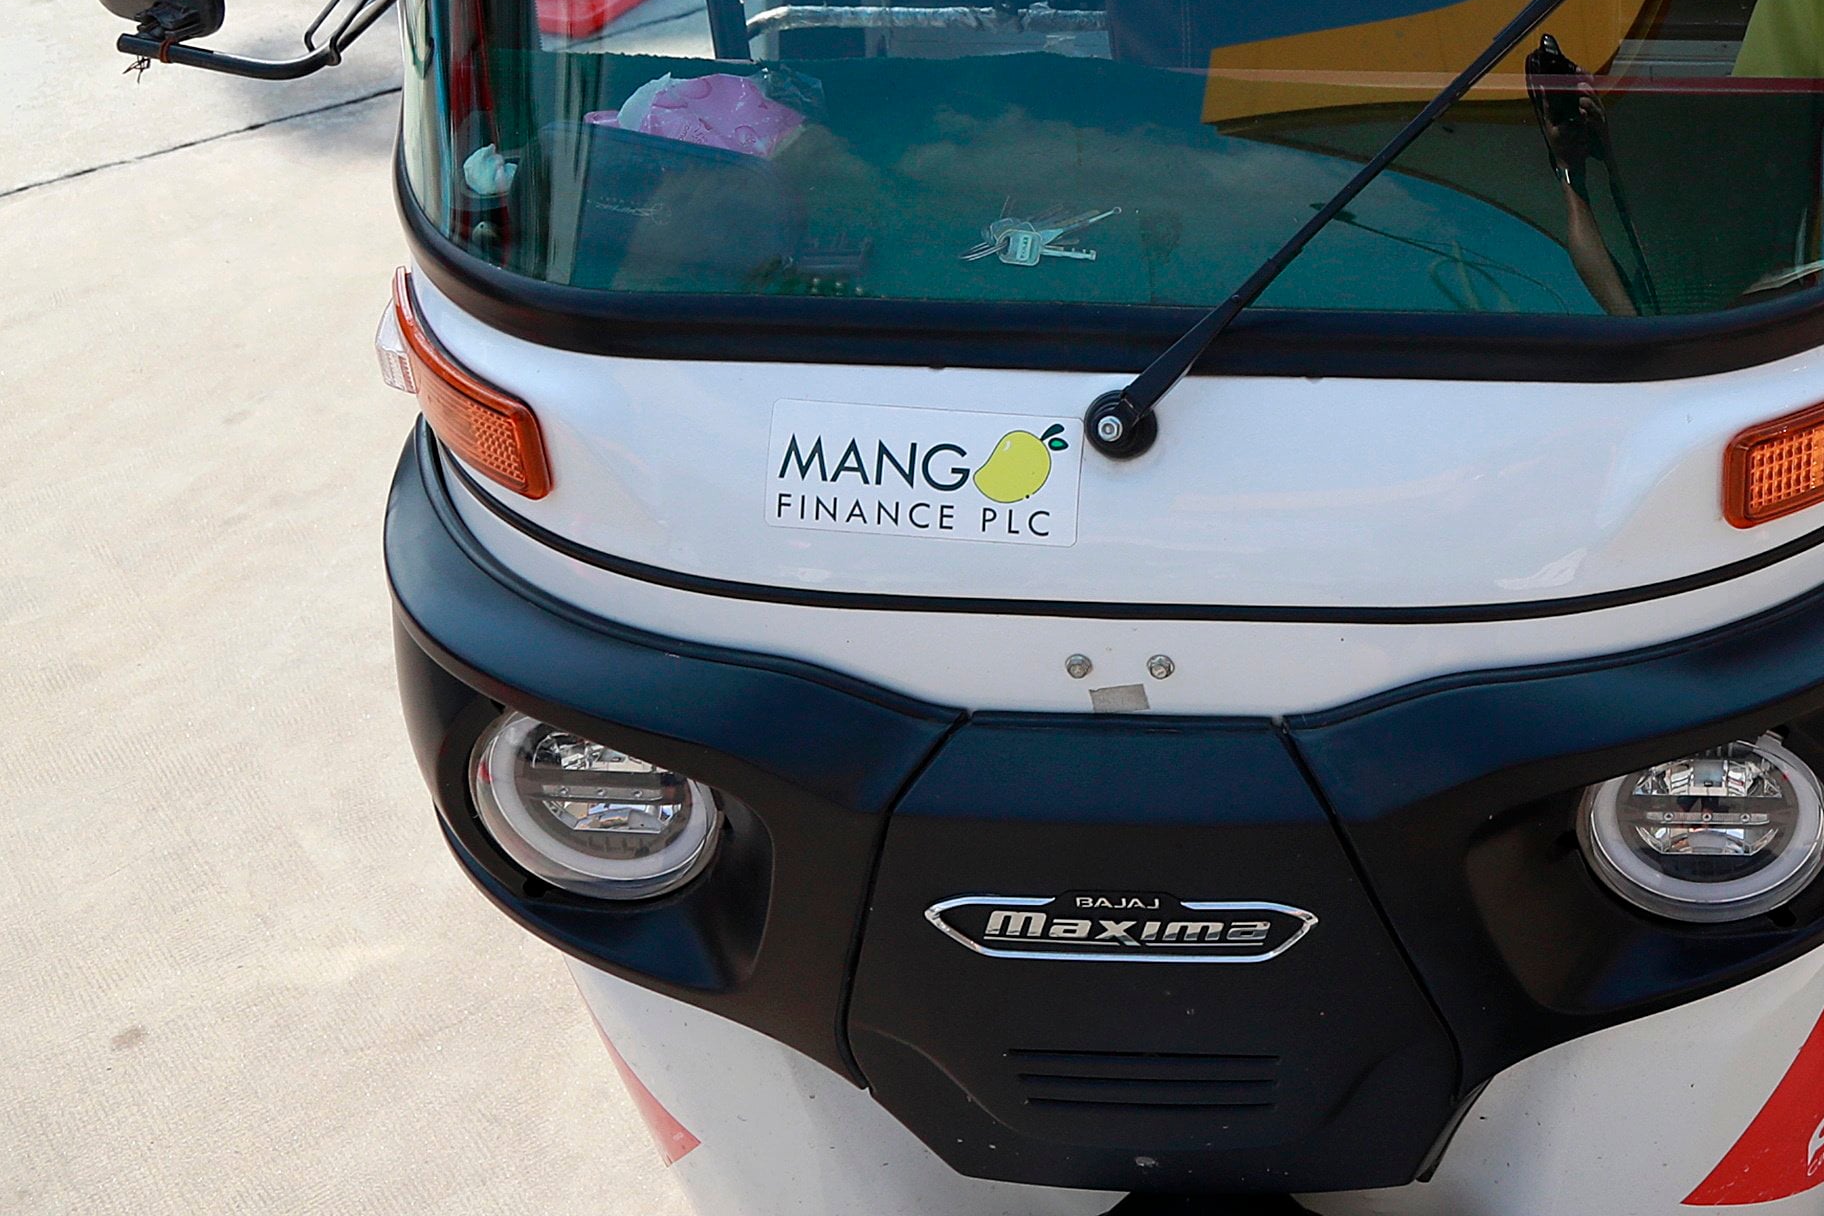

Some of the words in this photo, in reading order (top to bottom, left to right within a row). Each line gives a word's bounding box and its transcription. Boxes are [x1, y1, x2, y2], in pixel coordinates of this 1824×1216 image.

[777, 493, 955, 531] FINANCE
[981, 507, 1051, 538] PLC
[1075, 897, 1160, 909] BAJAJ
